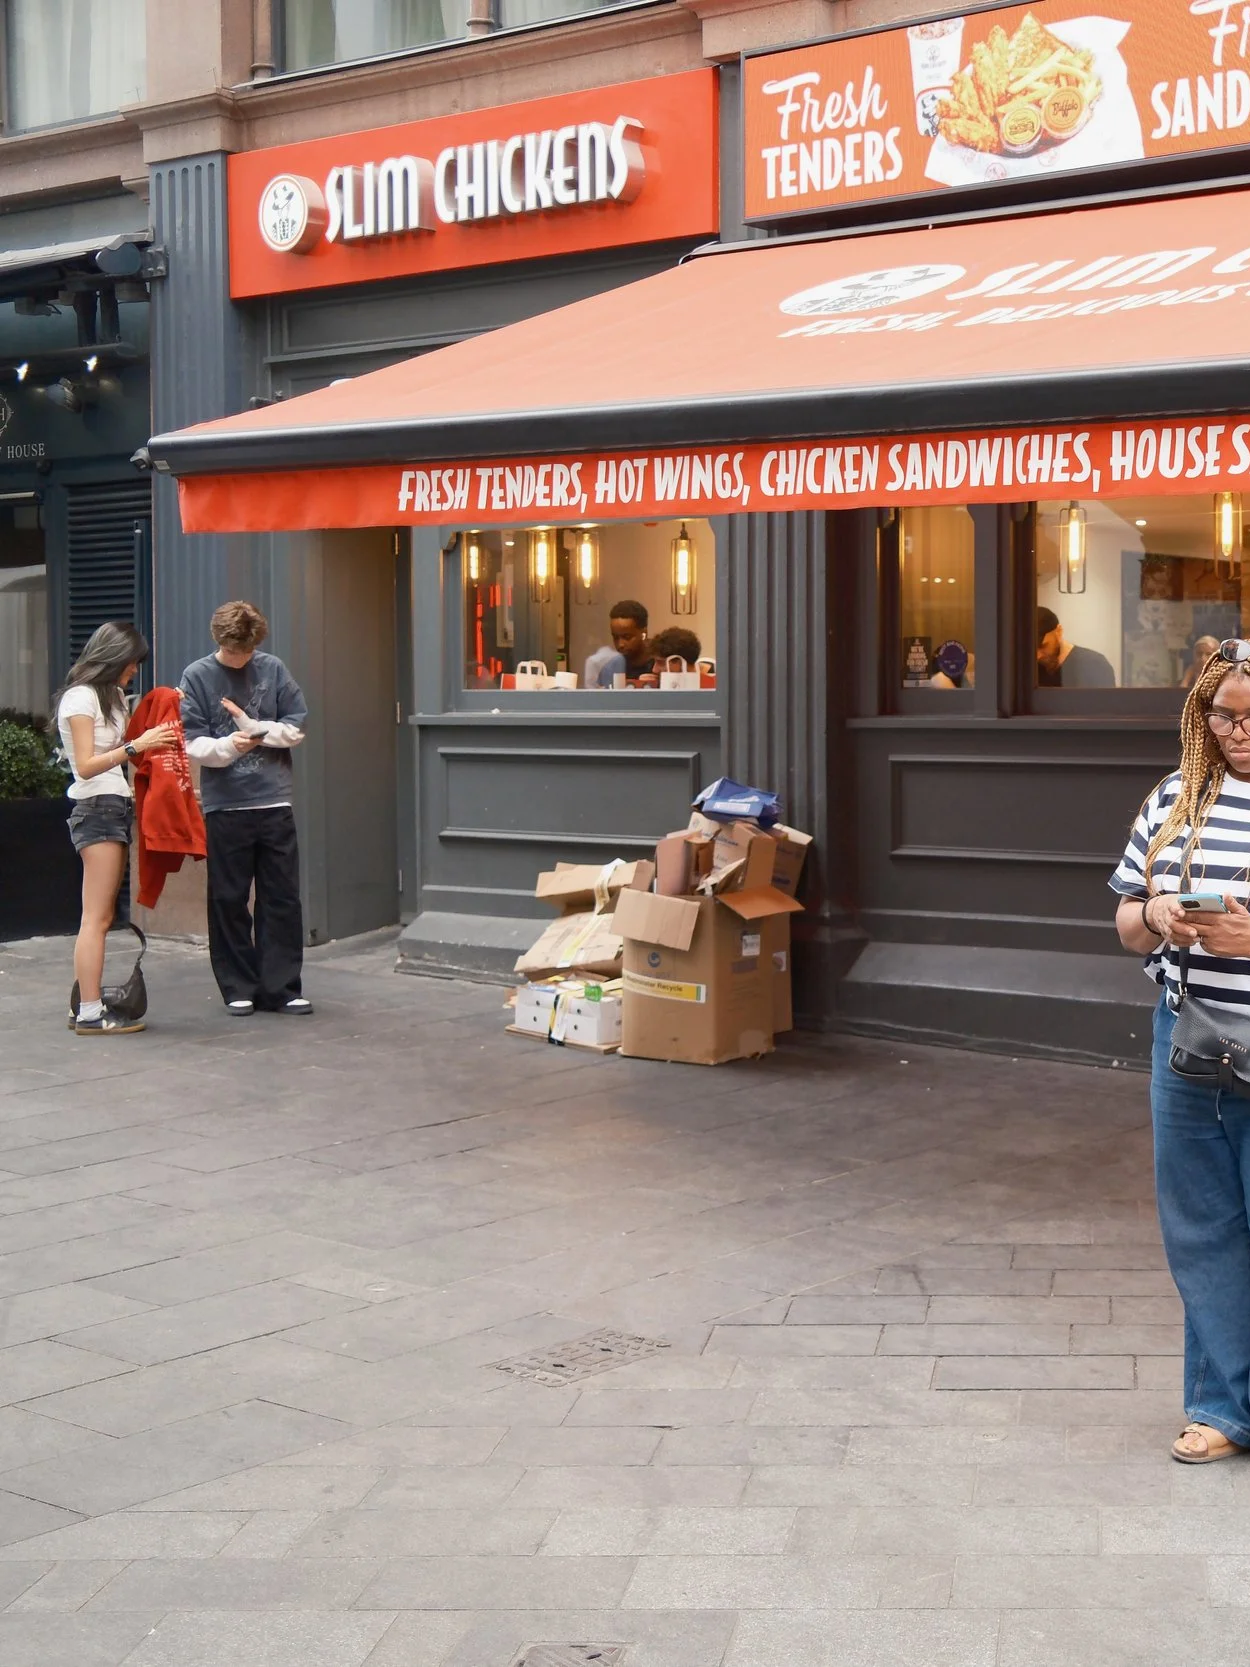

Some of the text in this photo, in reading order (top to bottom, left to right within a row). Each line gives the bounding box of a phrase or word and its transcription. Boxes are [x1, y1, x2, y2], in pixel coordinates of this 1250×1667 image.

[763, 66, 887, 140] Fresh
[1053, 100, 1078, 117] Buffalo
[325, 115, 632, 243] SLIM CHICKENS
[762, 127, 903, 199] TENDERS
[945, 247, 1217, 300] SLIM
[954, 281, 1238, 327] DELICIOUS
[7, 442, 46, 459] HOUSE
[398, 469, 471, 512] FRESH
[476, 461, 589, 514] TENDERS,
[594, 457, 648, 505] HOT
[654, 452, 751, 506] WINGS,
[759, 445, 878, 498] CHICKEN
[885, 431, 1101, 493] SANDWICHES,
[1109, 423, 1226, 482] HOUSE
[656, 982, 684, 993] Recycle
